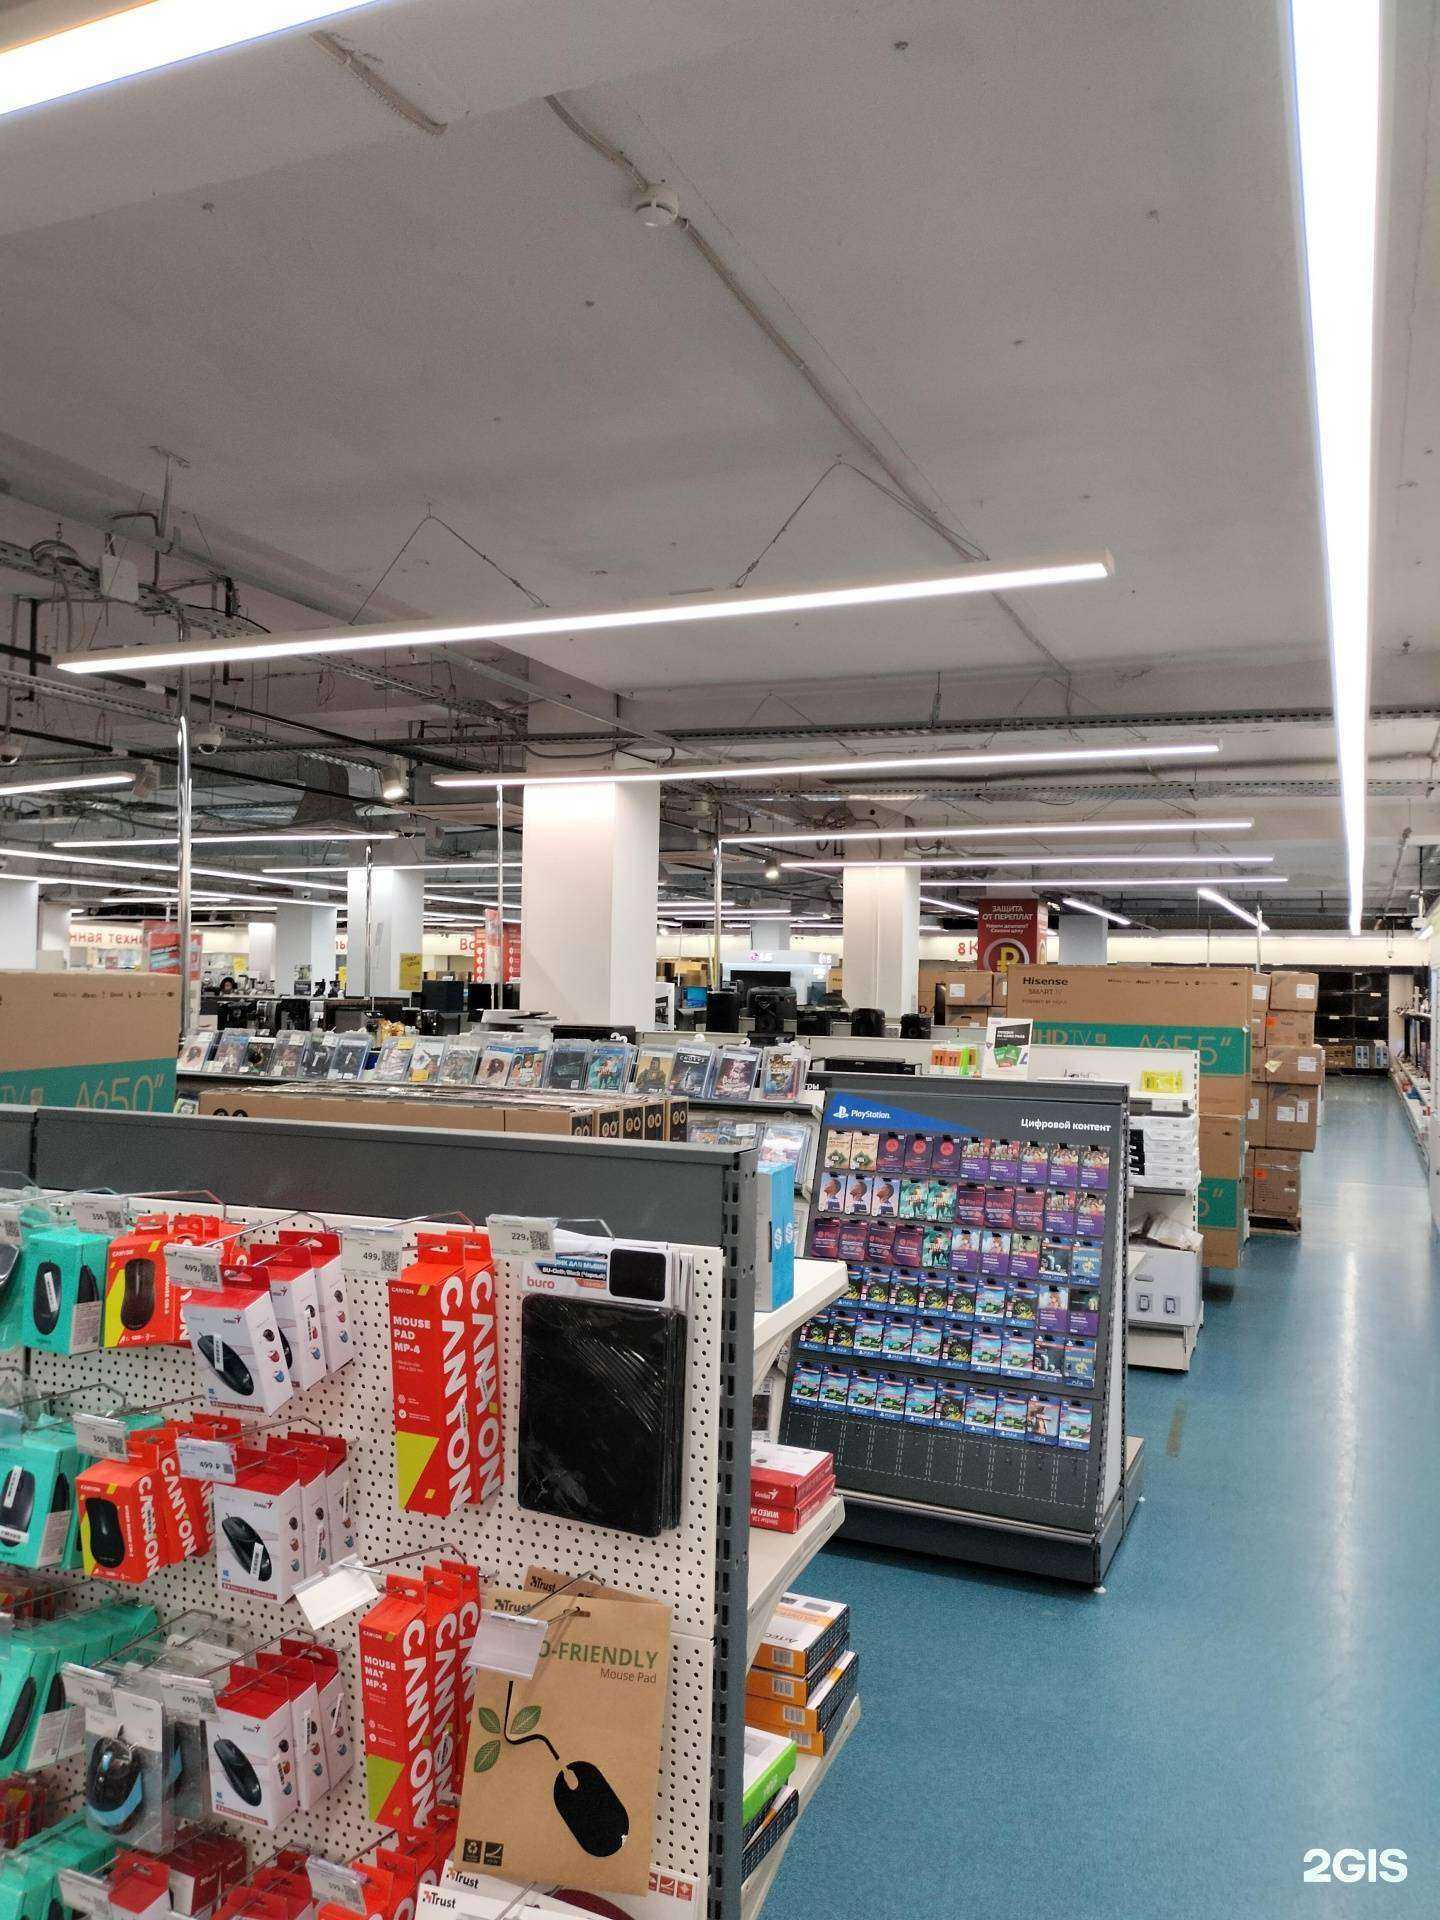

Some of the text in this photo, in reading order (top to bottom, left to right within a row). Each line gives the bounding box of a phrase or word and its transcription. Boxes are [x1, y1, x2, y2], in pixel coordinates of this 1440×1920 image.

[992, 905, 1024, 913] ЗАЩИТА
[1022, 976, 1069, 986] Hisense
[850, 1109, 890, 1119] PlayStation
[1021, 1118, 1112, 1132] Цифровой контент
[527, 1275, 555, 1289] buro
[392, 1287, 415, 1295] CANYON
[393, 1315, 431, 1330] MOUSE
[394, 1329, 415, 1340] PAD
[394, 1342, 421, 1354] MP-4
[161, 1457, 198, 1558] CANYON
[536, 1577, 557, 1592] Trust
[503, 1599, 533, 1615] Trust
[538, 1639, 659, 1669] O-FRIENDLY
[364, 1655, 397, 1671] MOUSE
[364, 1667, 385, 1679] MAT
[600, 1667, 657, 1684] Mouse Pad
[365, 1678, 388, 1691] MP-2
[403, 1619, 435, 1828] CANYON
[455, 1871, 480, 1889] Trust
[430, 1892, 456, 1909] Trust
